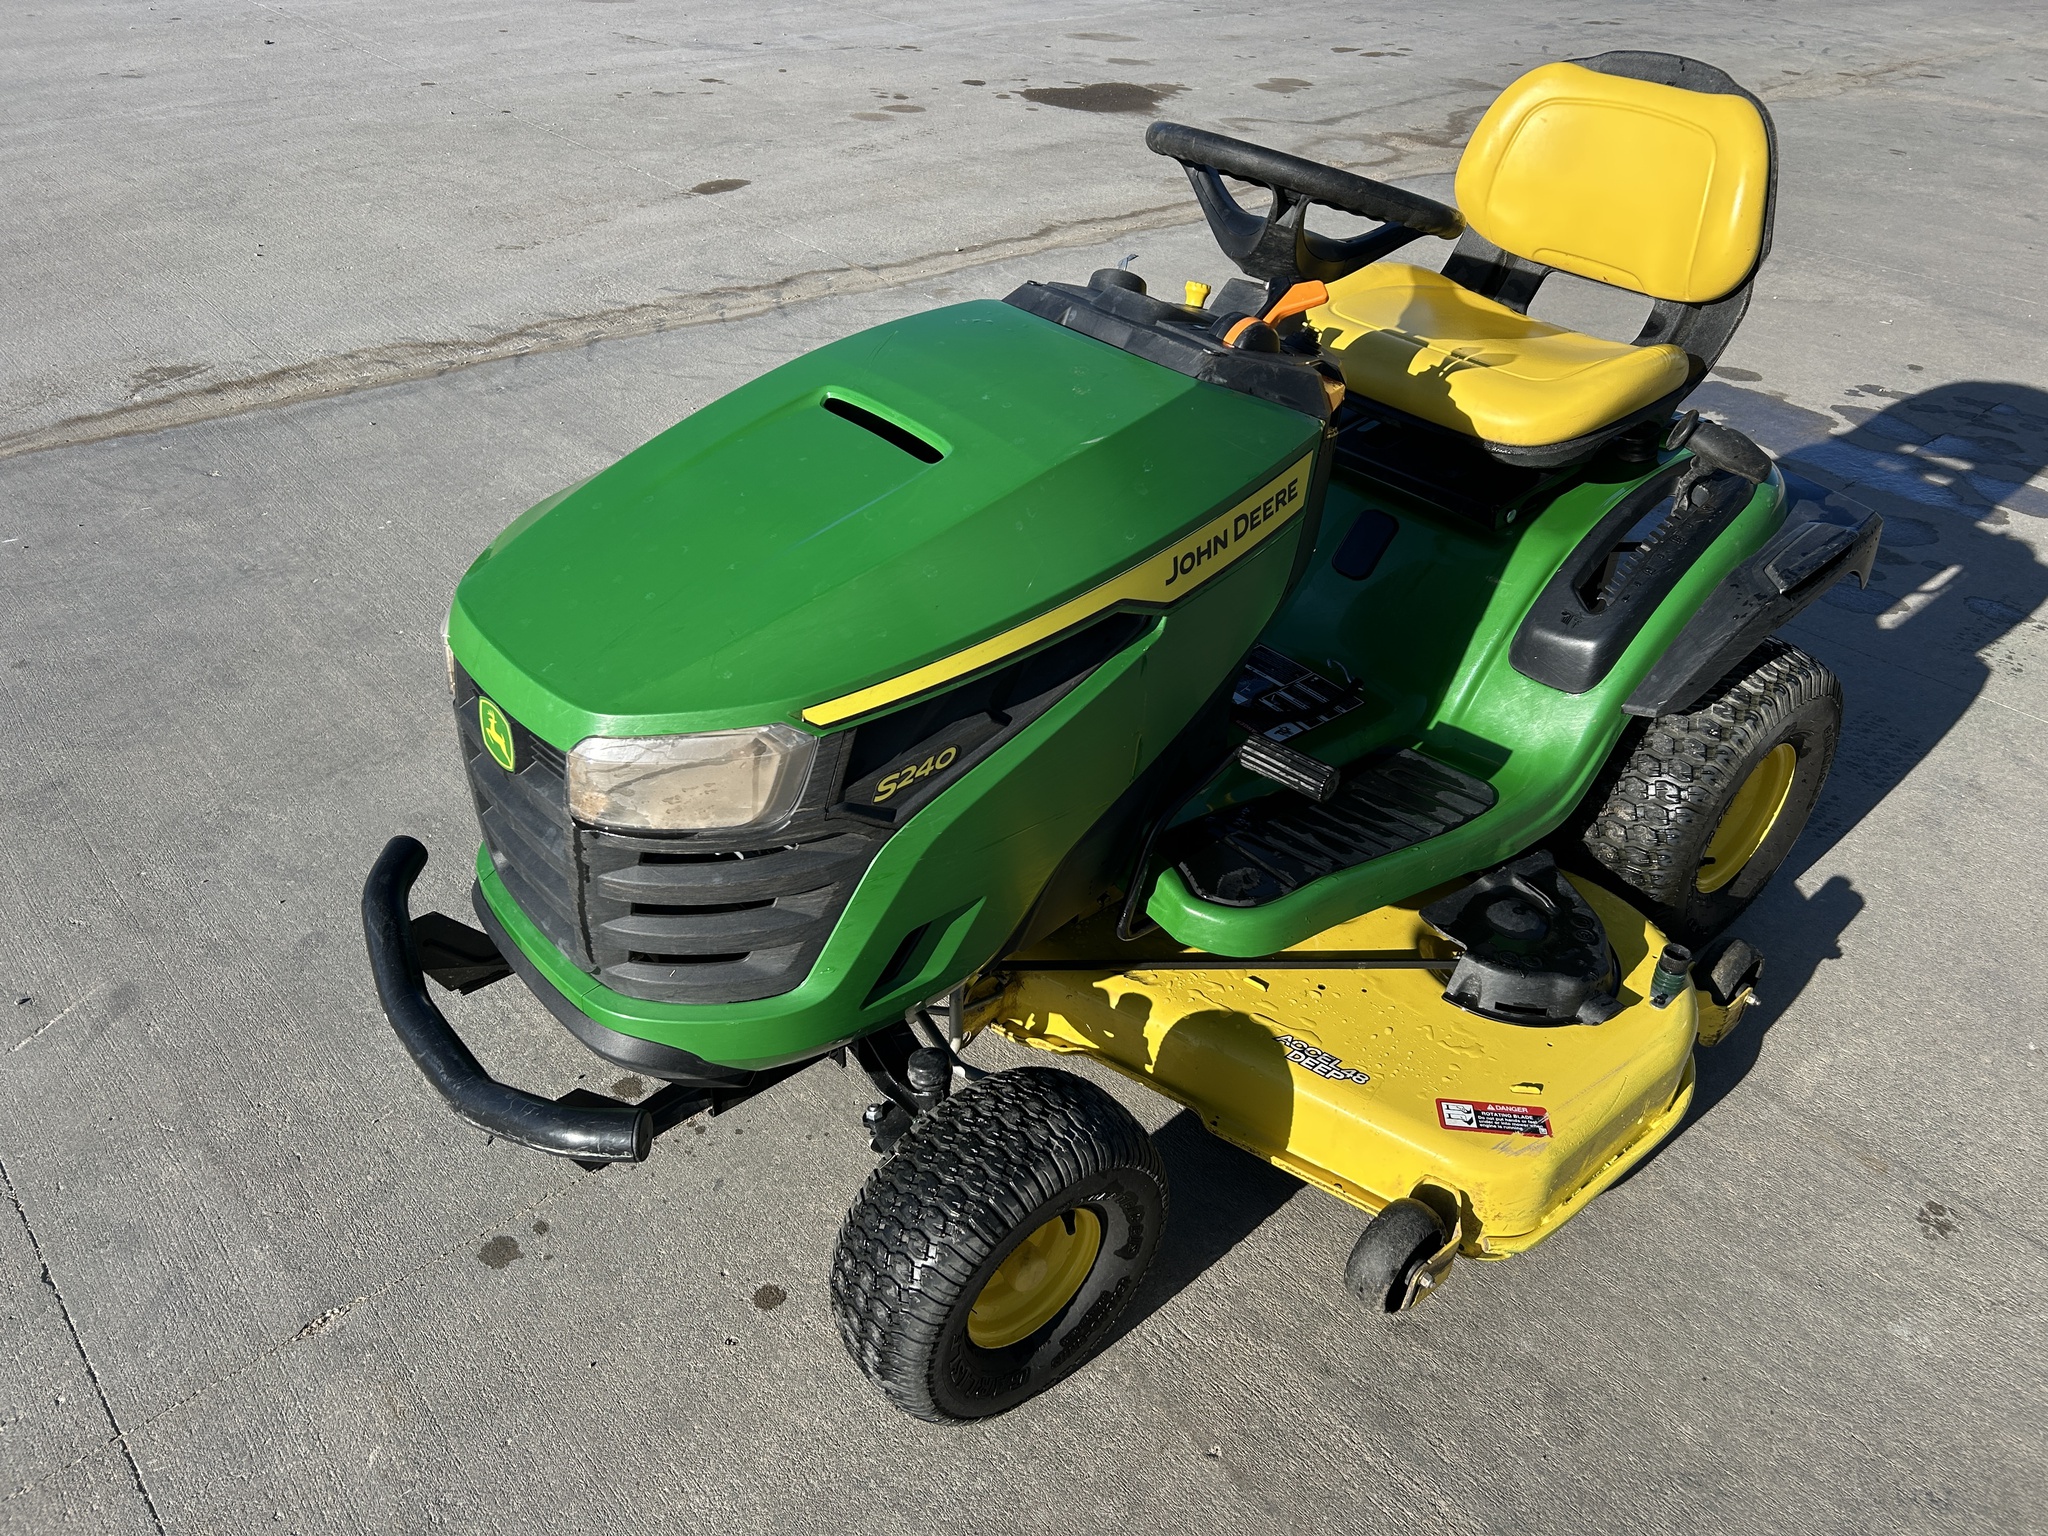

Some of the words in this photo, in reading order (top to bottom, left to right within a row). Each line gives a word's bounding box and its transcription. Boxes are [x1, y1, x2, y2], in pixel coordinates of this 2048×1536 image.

[1165, 528, 1228, 586] JOHN
[1234, 477, 1298, 542] DEERE
[873, 746, 957, 803] S240
[1273, 1034, 1342, 1071] ACCEL
[1284, 1049, 1345, 1081] DEEP
[1340, 1068, 1370, 1085] 48
[1495, 1104, 1528, 1113] DANGER
